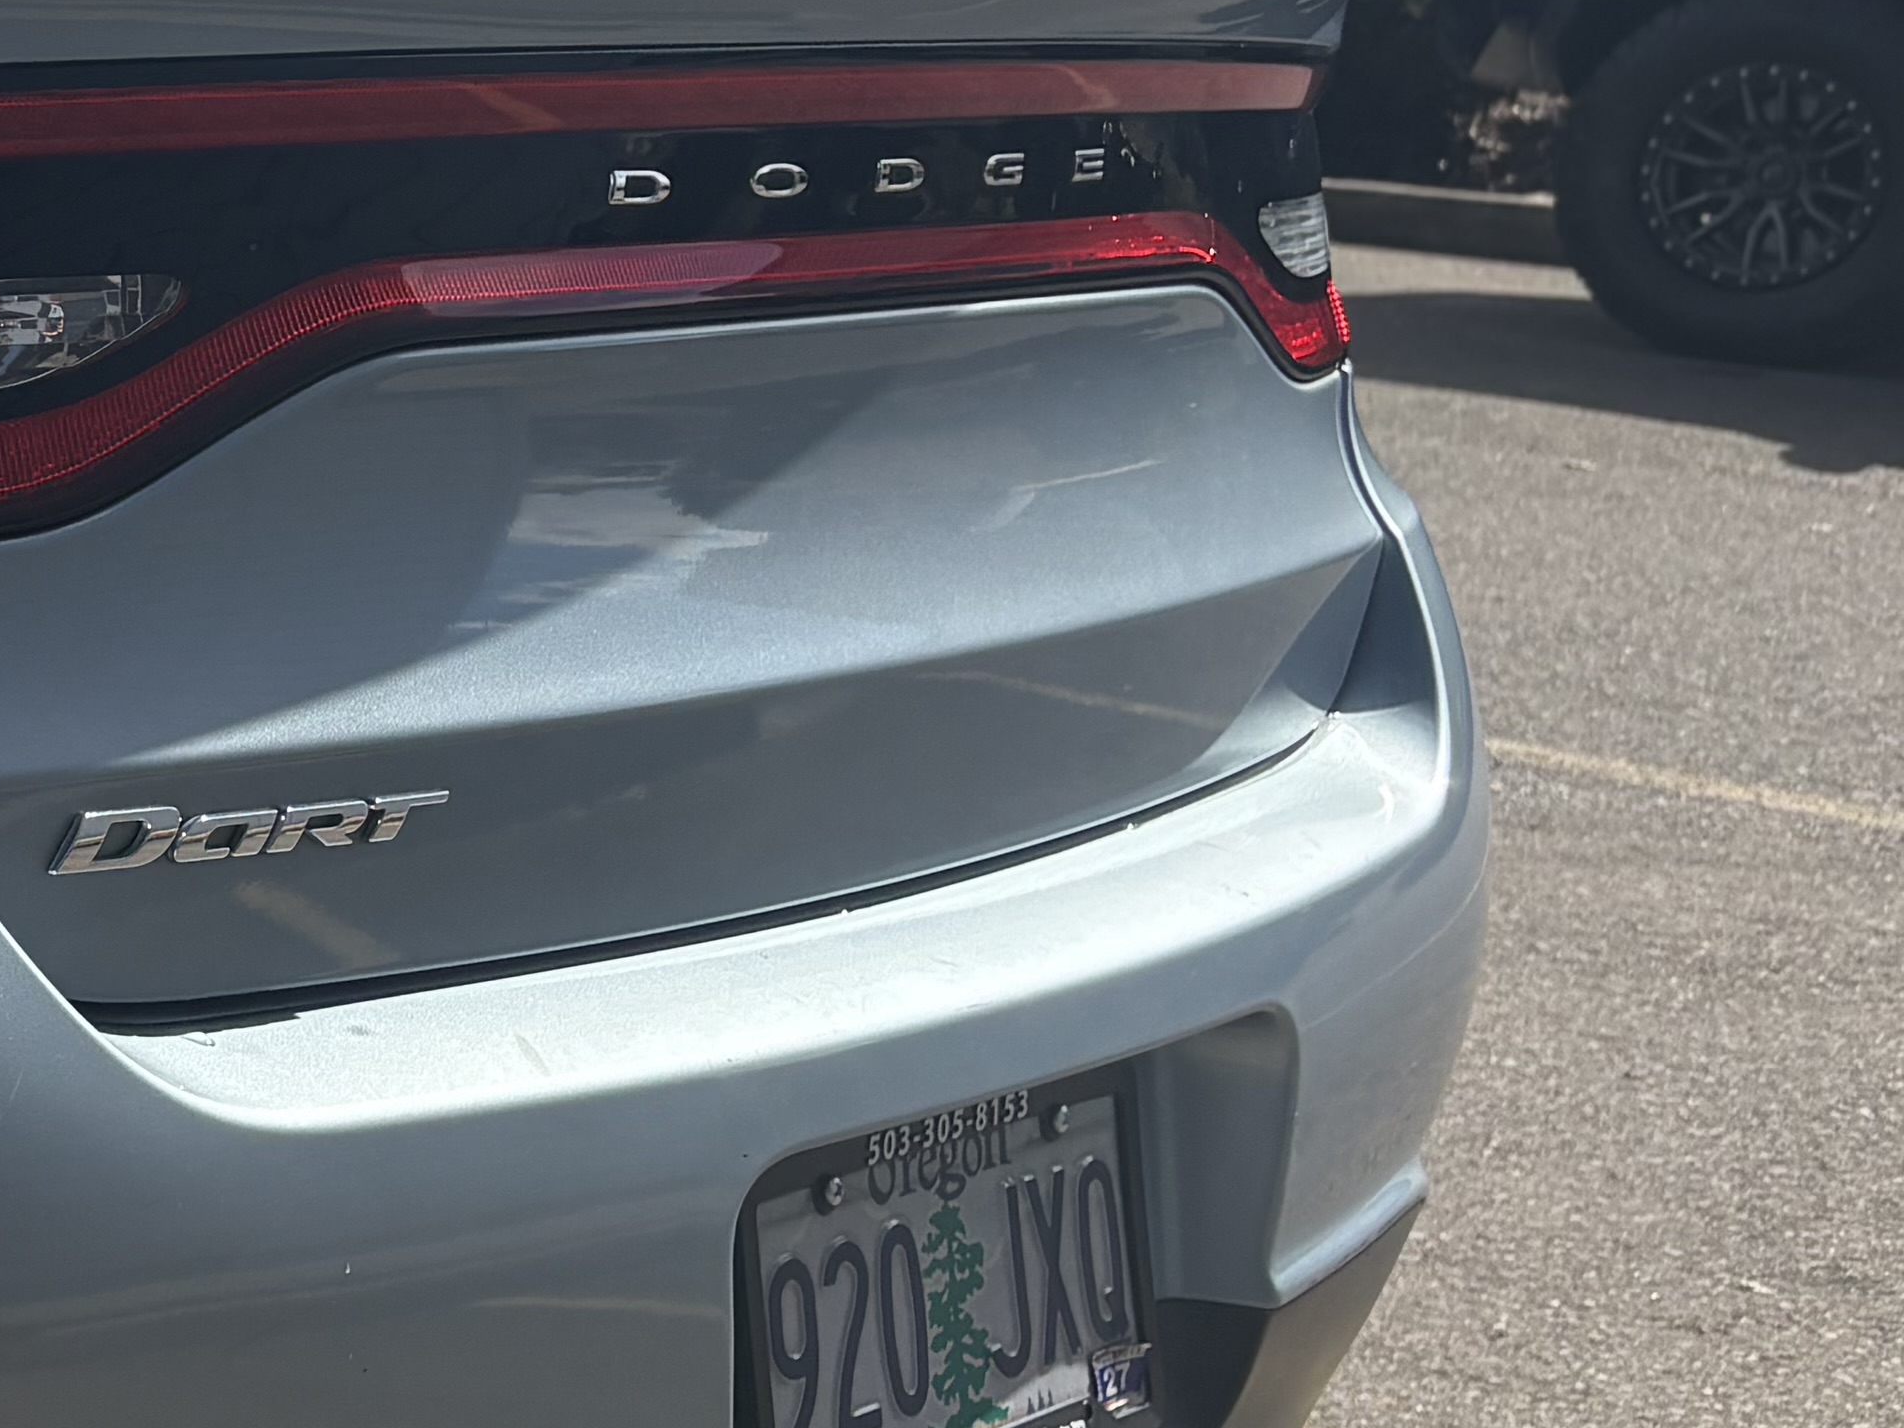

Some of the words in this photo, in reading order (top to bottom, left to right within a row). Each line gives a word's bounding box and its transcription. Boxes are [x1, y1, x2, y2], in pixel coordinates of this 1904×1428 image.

[608, 148, 1105, 206] DODGE
[867, 1089, 1029, 1166] 503-305-8153
[868, 1124, 1012, 1205] Oregon
[992, 1156, 1130, 1378] JXQ
[1103, 1359, 1130, 1398] 27
